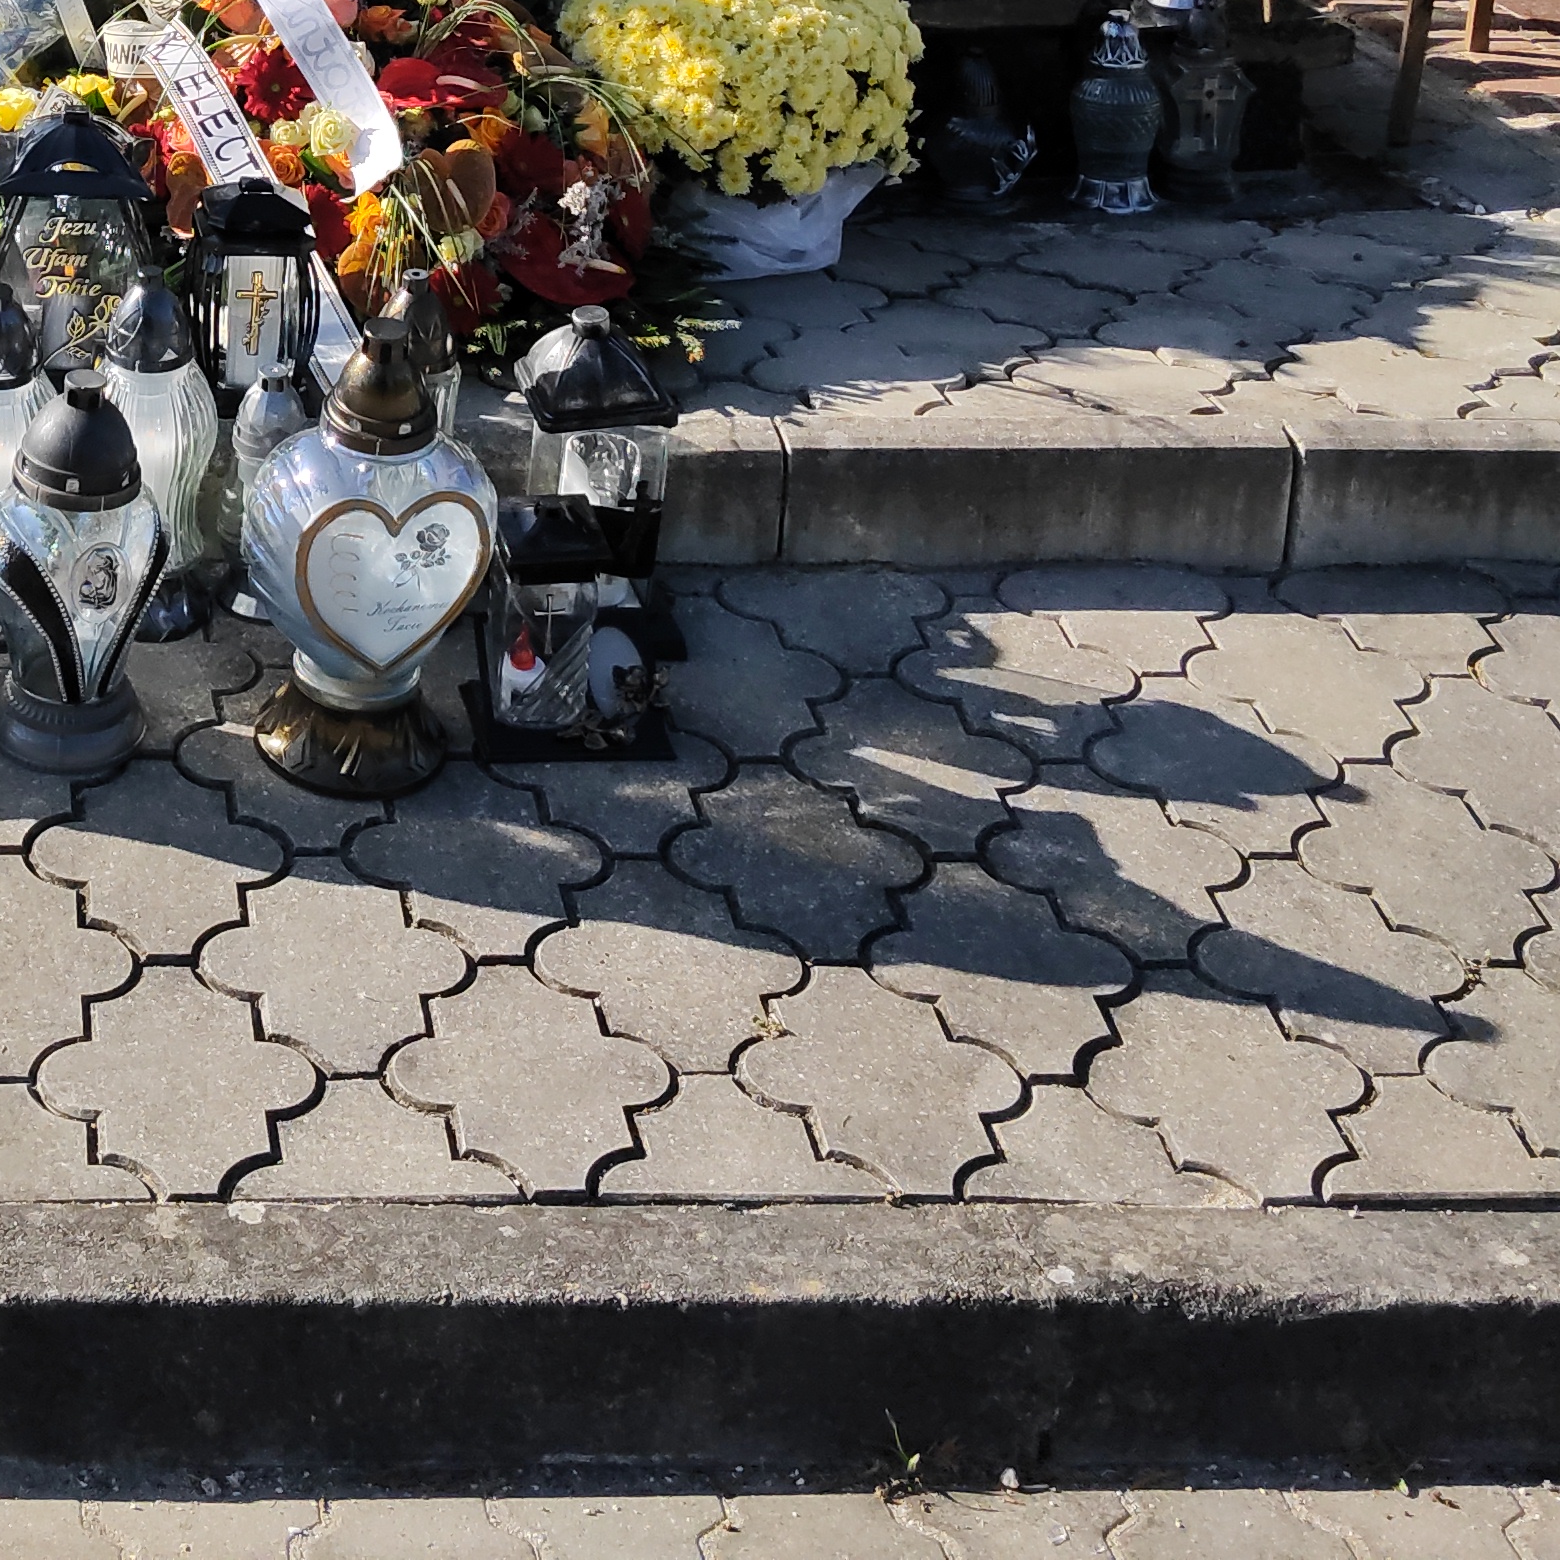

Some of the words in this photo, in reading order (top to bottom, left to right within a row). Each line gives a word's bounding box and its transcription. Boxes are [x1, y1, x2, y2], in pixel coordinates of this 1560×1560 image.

[38, 216, 97, 243] Jezu
[22, 247, 88, 275] Ufam
[35, 275, 102, 299] Tobie
